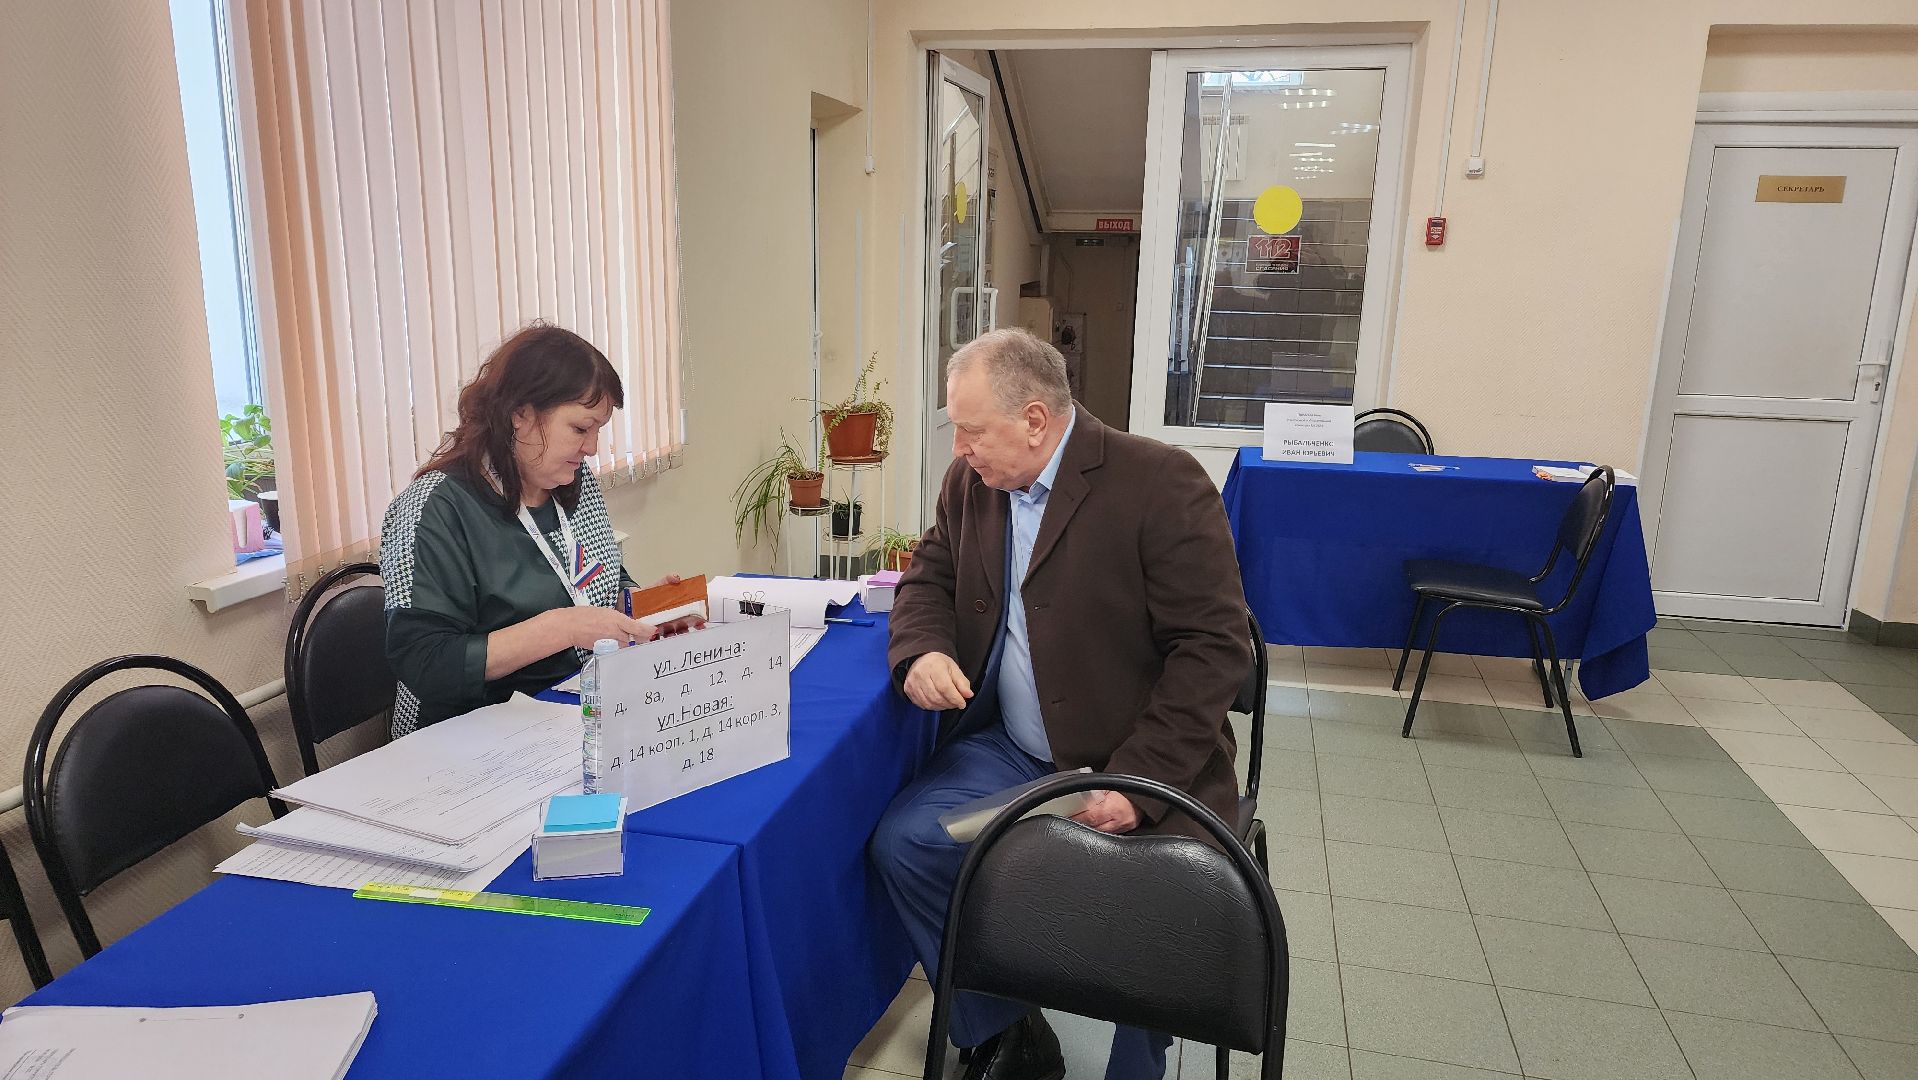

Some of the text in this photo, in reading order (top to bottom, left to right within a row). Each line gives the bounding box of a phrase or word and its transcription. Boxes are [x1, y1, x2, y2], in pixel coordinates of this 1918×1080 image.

[1098, 221, 1130, 230] ВЫХОД
[1254, 238, 1293, 259] 112
[653, 660, 677, 678] ул.
[614, 700, 628, 716] д.
[644, 690, 665, 705] 8а,
[680, 682, 693, 698] д.
[741, 666, 753, 679] д.
[768, 655, 783, 670] 14
[611, 756, 624, 771] д.
[629, 745, 645, 763] 14
[689, 729, 700, 743] 1,
[702, 726, 714, 743] д.
[718, 719, 732, 734] 14
[770, 703, 782, 718] 3,
[681, 747, 715, 772] д. 18
